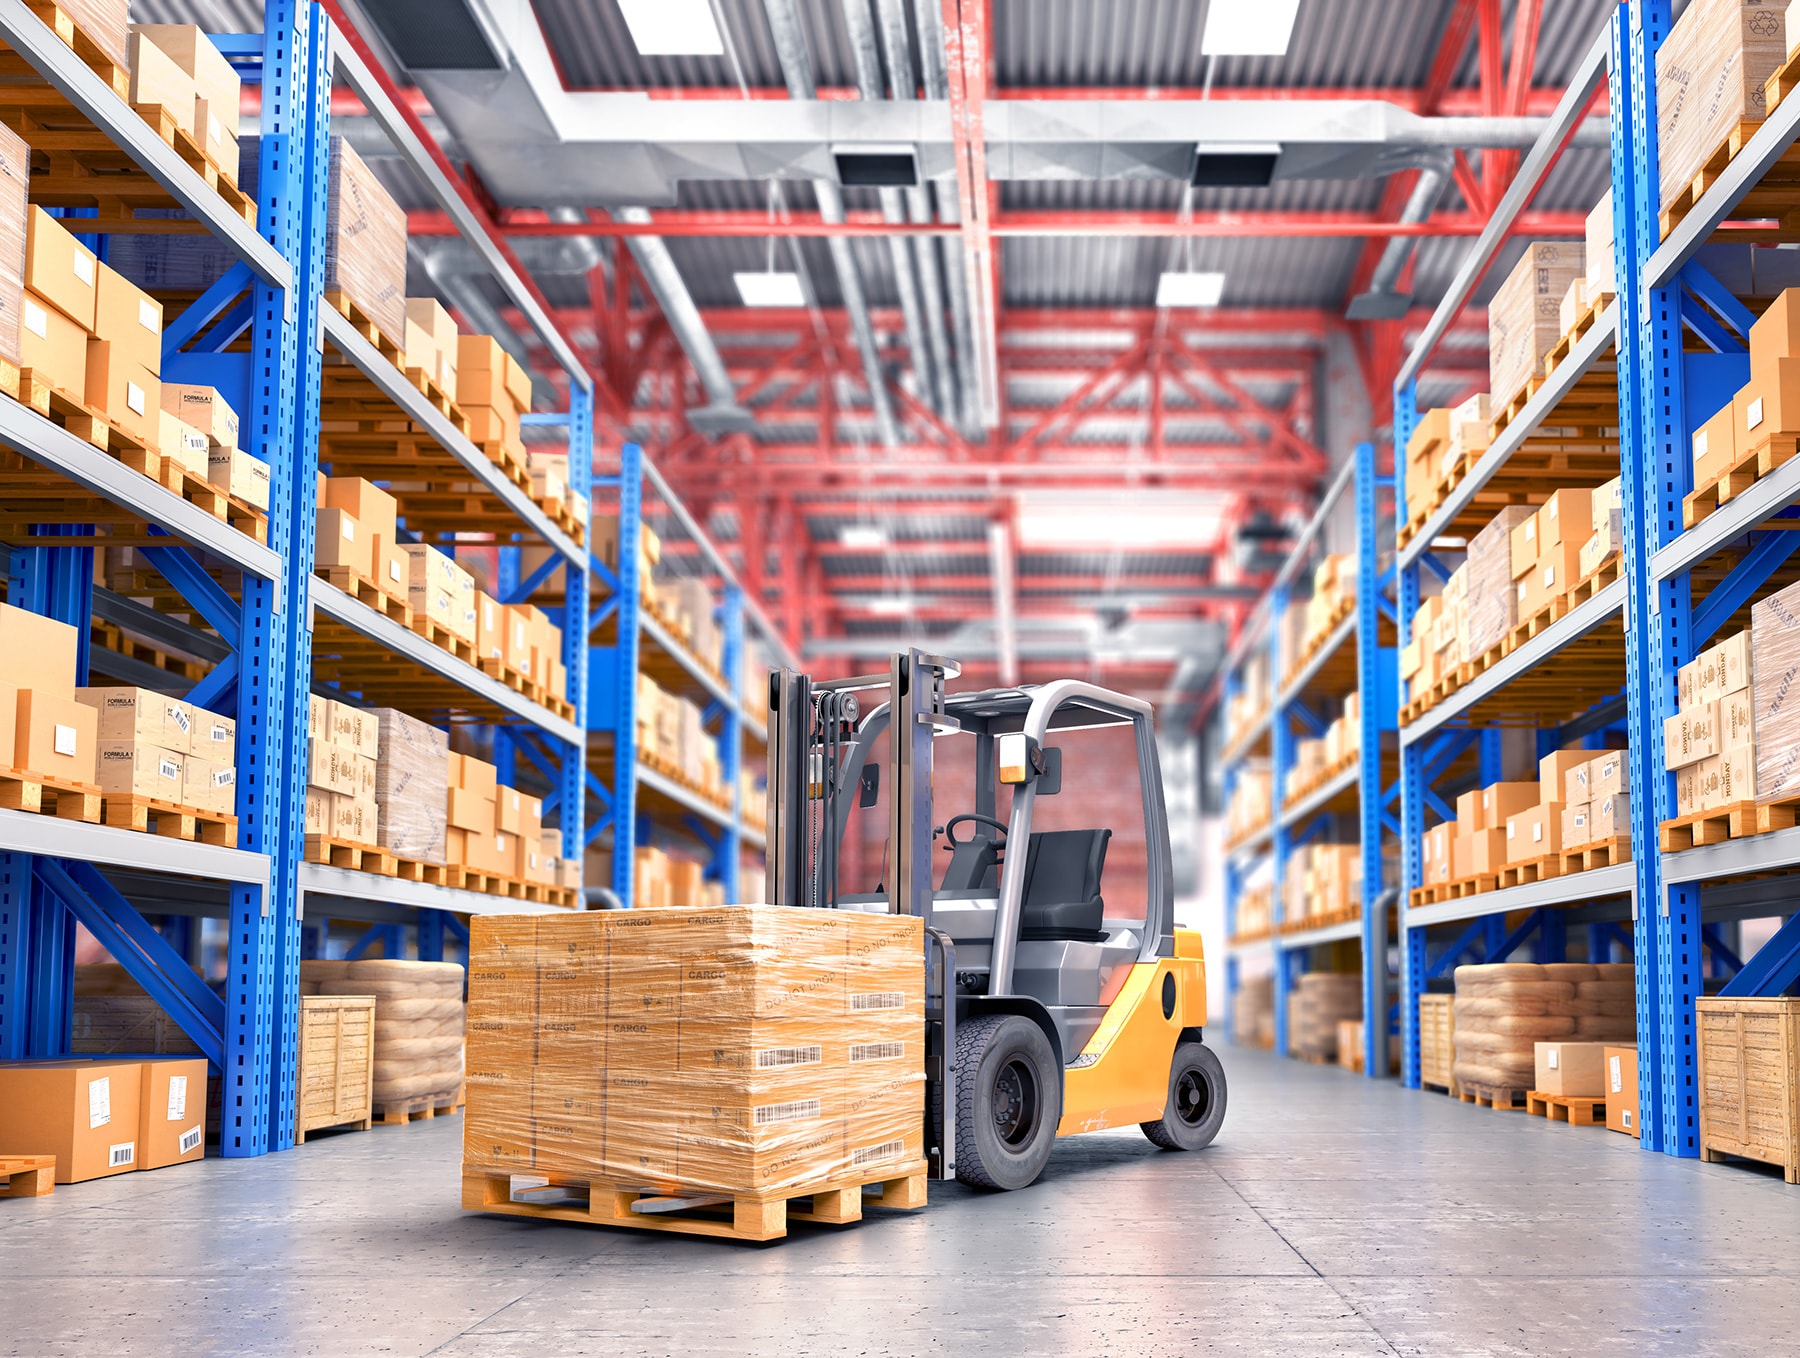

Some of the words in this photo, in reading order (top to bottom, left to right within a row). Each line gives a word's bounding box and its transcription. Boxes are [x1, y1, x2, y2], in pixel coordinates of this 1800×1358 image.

[616, 918, 652, 926] CARGO
[688, 916, 724, 924] CARGO
[856, 944, 870, 957] DO
[545, 972, 576, 980] CARGO
[688, 971, 726, 979] CARGO
[544, 1023, 576, 1032] CARGO
[613, 1024, 647, 1032] CARGO
[472, 1072, 504, 1080] CARGO
[613, 1078, 648, 1087] CARGO
[762, 1162, 778, 1178] DO
